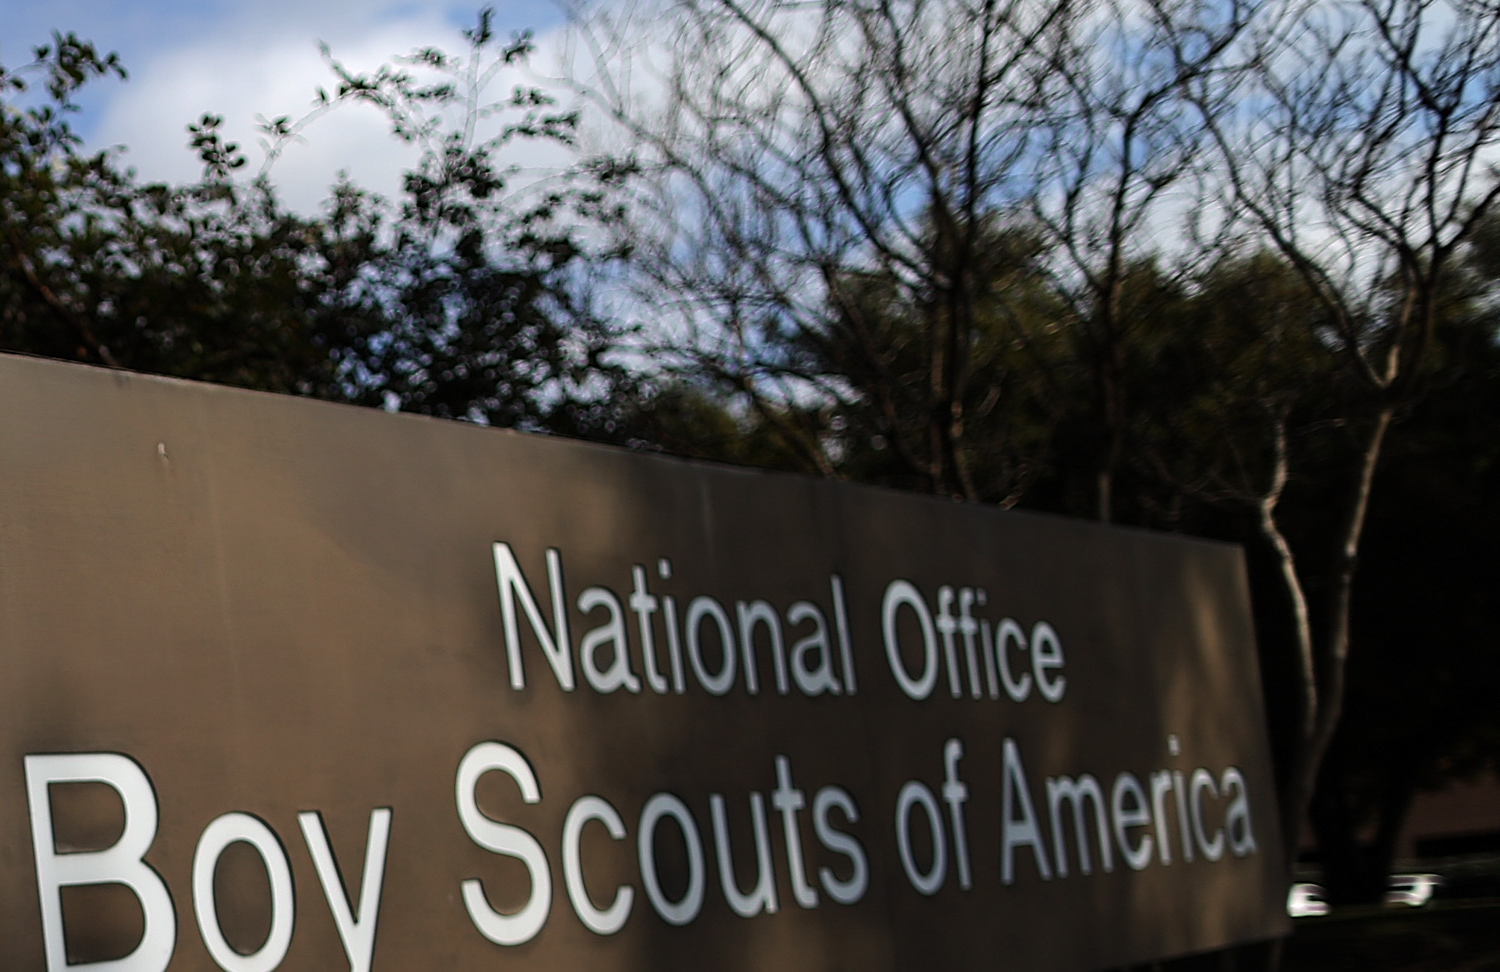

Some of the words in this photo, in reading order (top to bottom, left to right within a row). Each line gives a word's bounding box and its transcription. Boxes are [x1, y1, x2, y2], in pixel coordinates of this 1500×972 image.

[492, 541, 857, 696] National
[882, 579, 1066, 703] Office
[455, 740, 868, 947] Scouts
[896, 738, 971, 895] of
[1000, 735, 1256, 886] America
